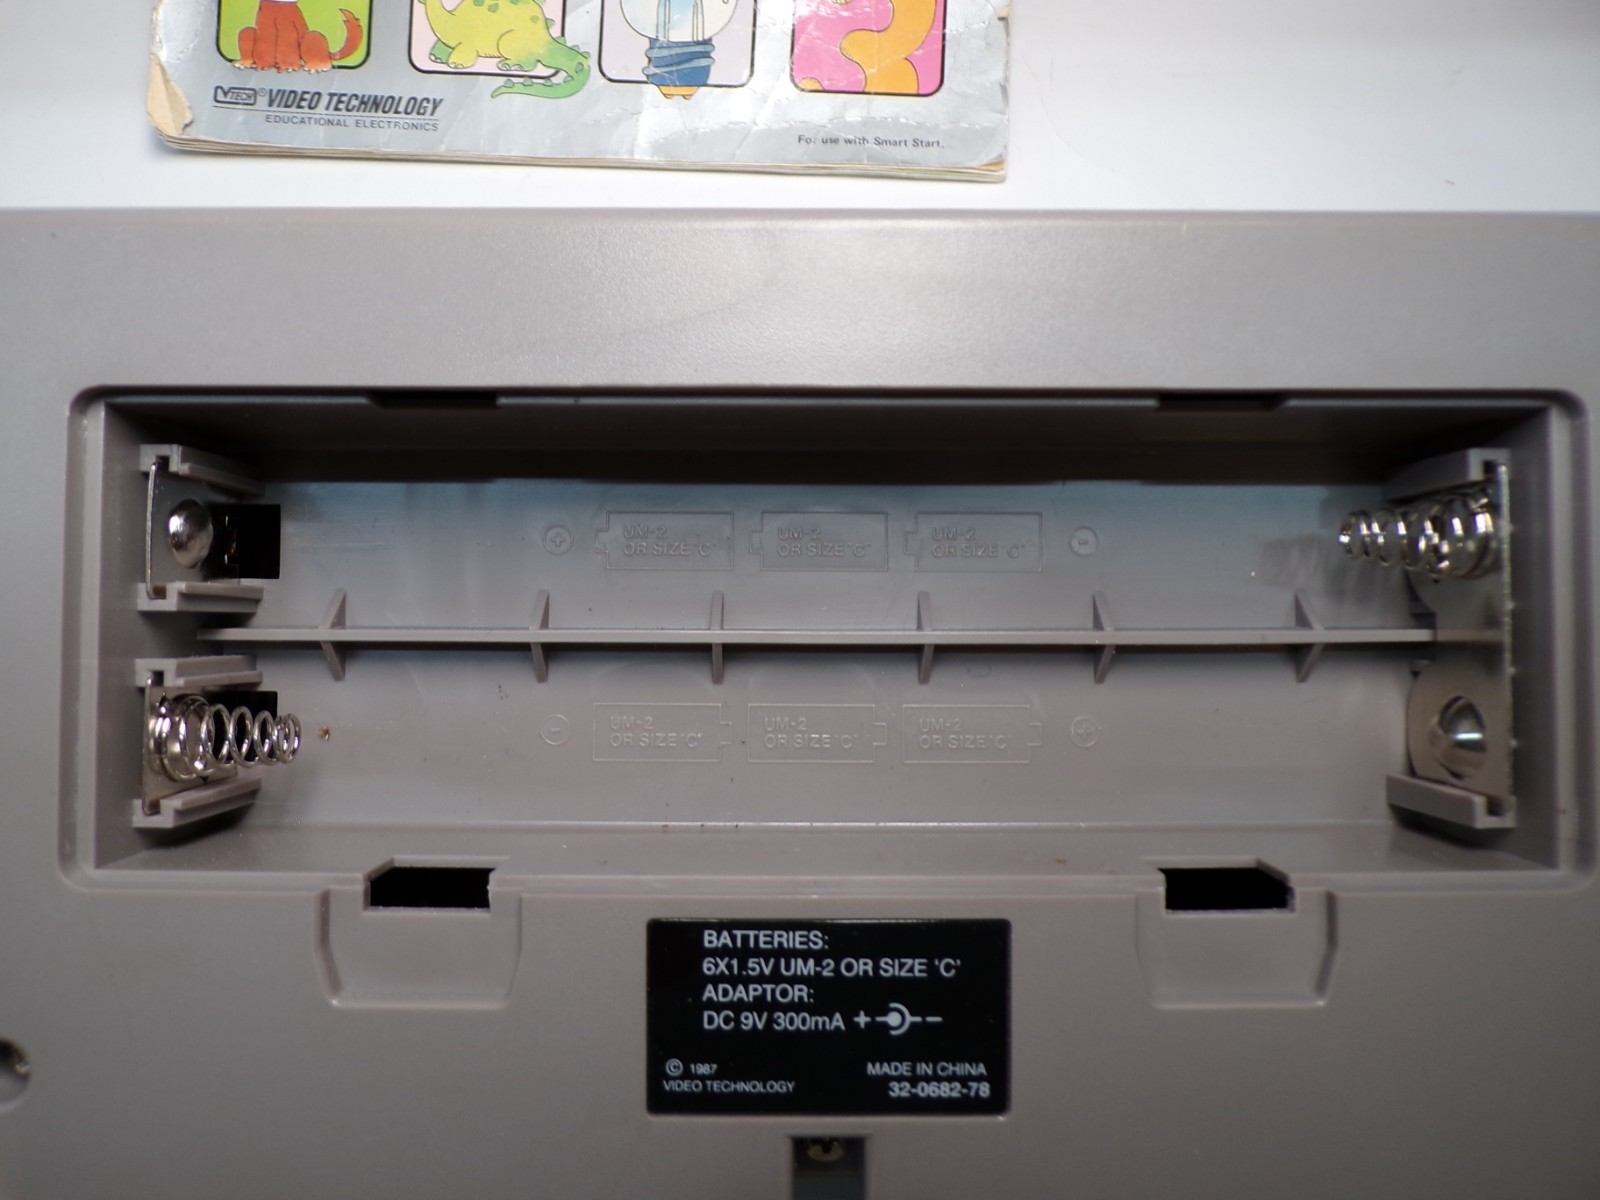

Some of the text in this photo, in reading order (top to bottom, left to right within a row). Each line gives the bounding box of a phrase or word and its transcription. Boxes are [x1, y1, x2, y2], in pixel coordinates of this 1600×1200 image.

[267, 88, 444, 117] VIDEO TECHNOLOGY
[265, 114, 440, 132] EDUCATIONAL ELECTRONICS
[821, 137, 840, 145] use
[844, 136, 869, 145] with
[873, 136, 908, 147] Smart
[912, 137, 945, 148] Start.
[624, 525, 666, 540] UM-2
[778, 527, 820, 542] UM-2
[932, 527, 975, 542] UM-2
[624, 542, 647, 557] OR
[653, 542, 690, 557] SIZE
[778, 543, 801, 558] OR
[807, 543, 844, 558] SIZE
[932, 544, 956, 559] OR
[960, 544, 998, 559] SIZE
[610, 715, 653, 730] UM-2
[765, 716, 808, 731] UM-2
[920, 717, 962, 732] UM-2
[610, 732, 633, 747] OR
[639, 732, 677, 747] SIZE
[765, 733, 788, 748] OR
[793, 733, 831, 748] SIZE
[920, 734, 942, 749] OR
[948, 734, 986, 749] SIZE
[703, 930, 829, 949] BATTERIES:
[702, 957, 774, 977] 6X1.5V
[780, 958, 835, 977] UM-2
[841, 958, 873, 977] OR
[879, 958, 928, 977] SIZE
[702, 984, 815, 1003] ADAPTOR:
[703, 1011, 846, 1031] DC 9V 300mA
[689, 1063, 717, 1075] 1987
[867, 1062, 987, 1077] MADE IN CHINA
[663, 1080, 796, 1093] VIDEO TECHNOLOGY
[888, 1082, 991, 1098] 32-0682-78
